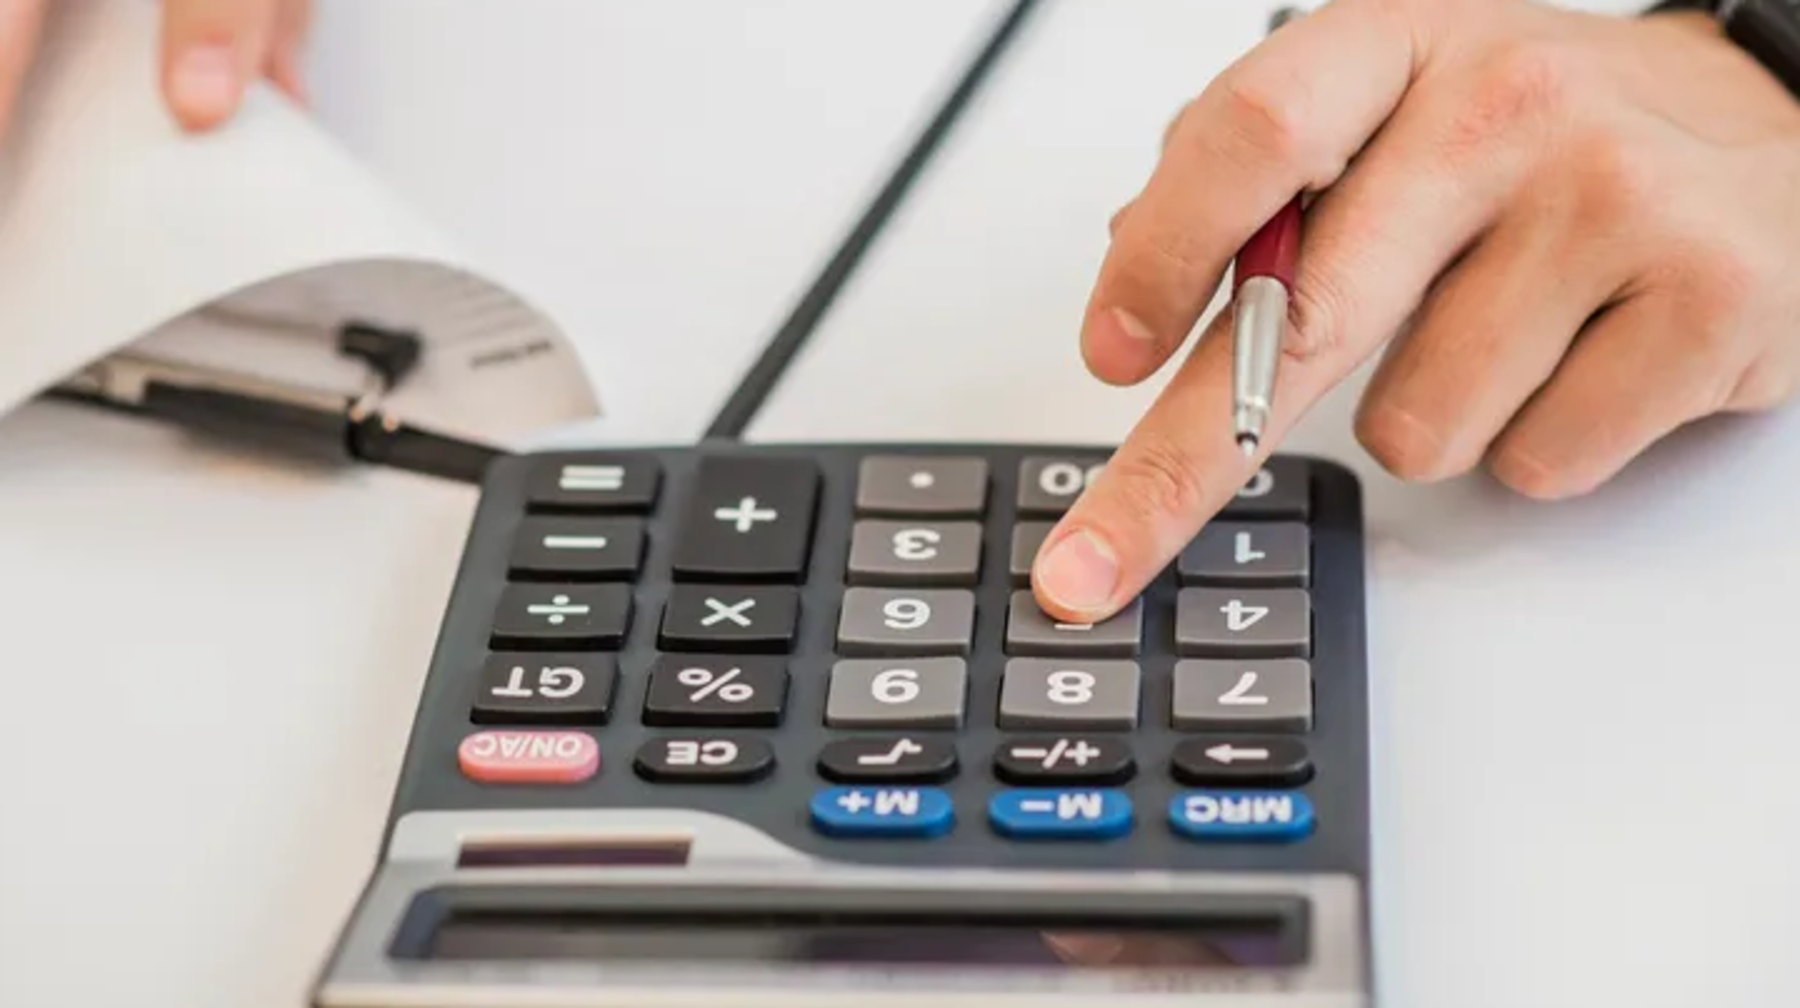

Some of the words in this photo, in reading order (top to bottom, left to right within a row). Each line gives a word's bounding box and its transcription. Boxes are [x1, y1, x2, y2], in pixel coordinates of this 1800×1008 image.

[893, 529, 940, 560] 3
[1234, 532, 1266, 564] 1
[883, 598, 931, 629] 6
[1219, 599, 1269, 631] 4
[491, 666, 585, 698] GT
[677, 668, 754, 702] %
[871, 669, 920, 703] 9
[1047, 671, 1096, 704] 8
[1218, 671, 1268, 705] 7
[472, 734, 583, 759] ON/AC
[666, 740, 738, 765] CE
[838, 790, 919, 815] M+
[1185, 796, 1292, 823] MRC
